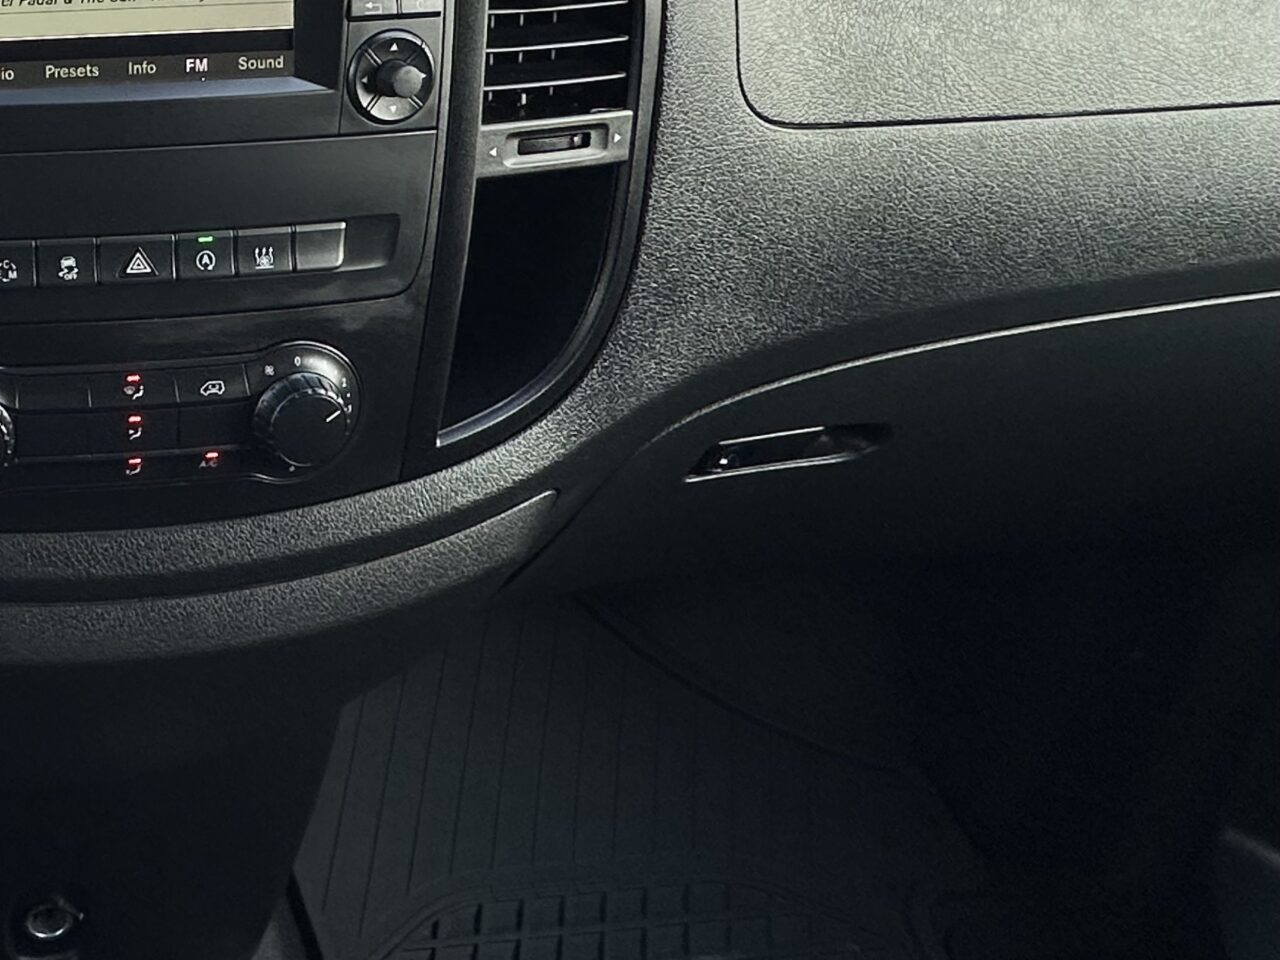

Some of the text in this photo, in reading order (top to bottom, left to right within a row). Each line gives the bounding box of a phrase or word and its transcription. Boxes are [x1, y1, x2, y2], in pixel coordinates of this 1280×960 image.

[45, 63, 100, 79] Presets
[128, 60, 157, 75] Info
[186, 57, 208, 73] FM
[237, 55, 284, 71] Sound
[3, 260, 10, 269] C
[201, 253, 212, 266] A
[8, 270, 18, 279] M
[293, 355, 302, 367] 0
